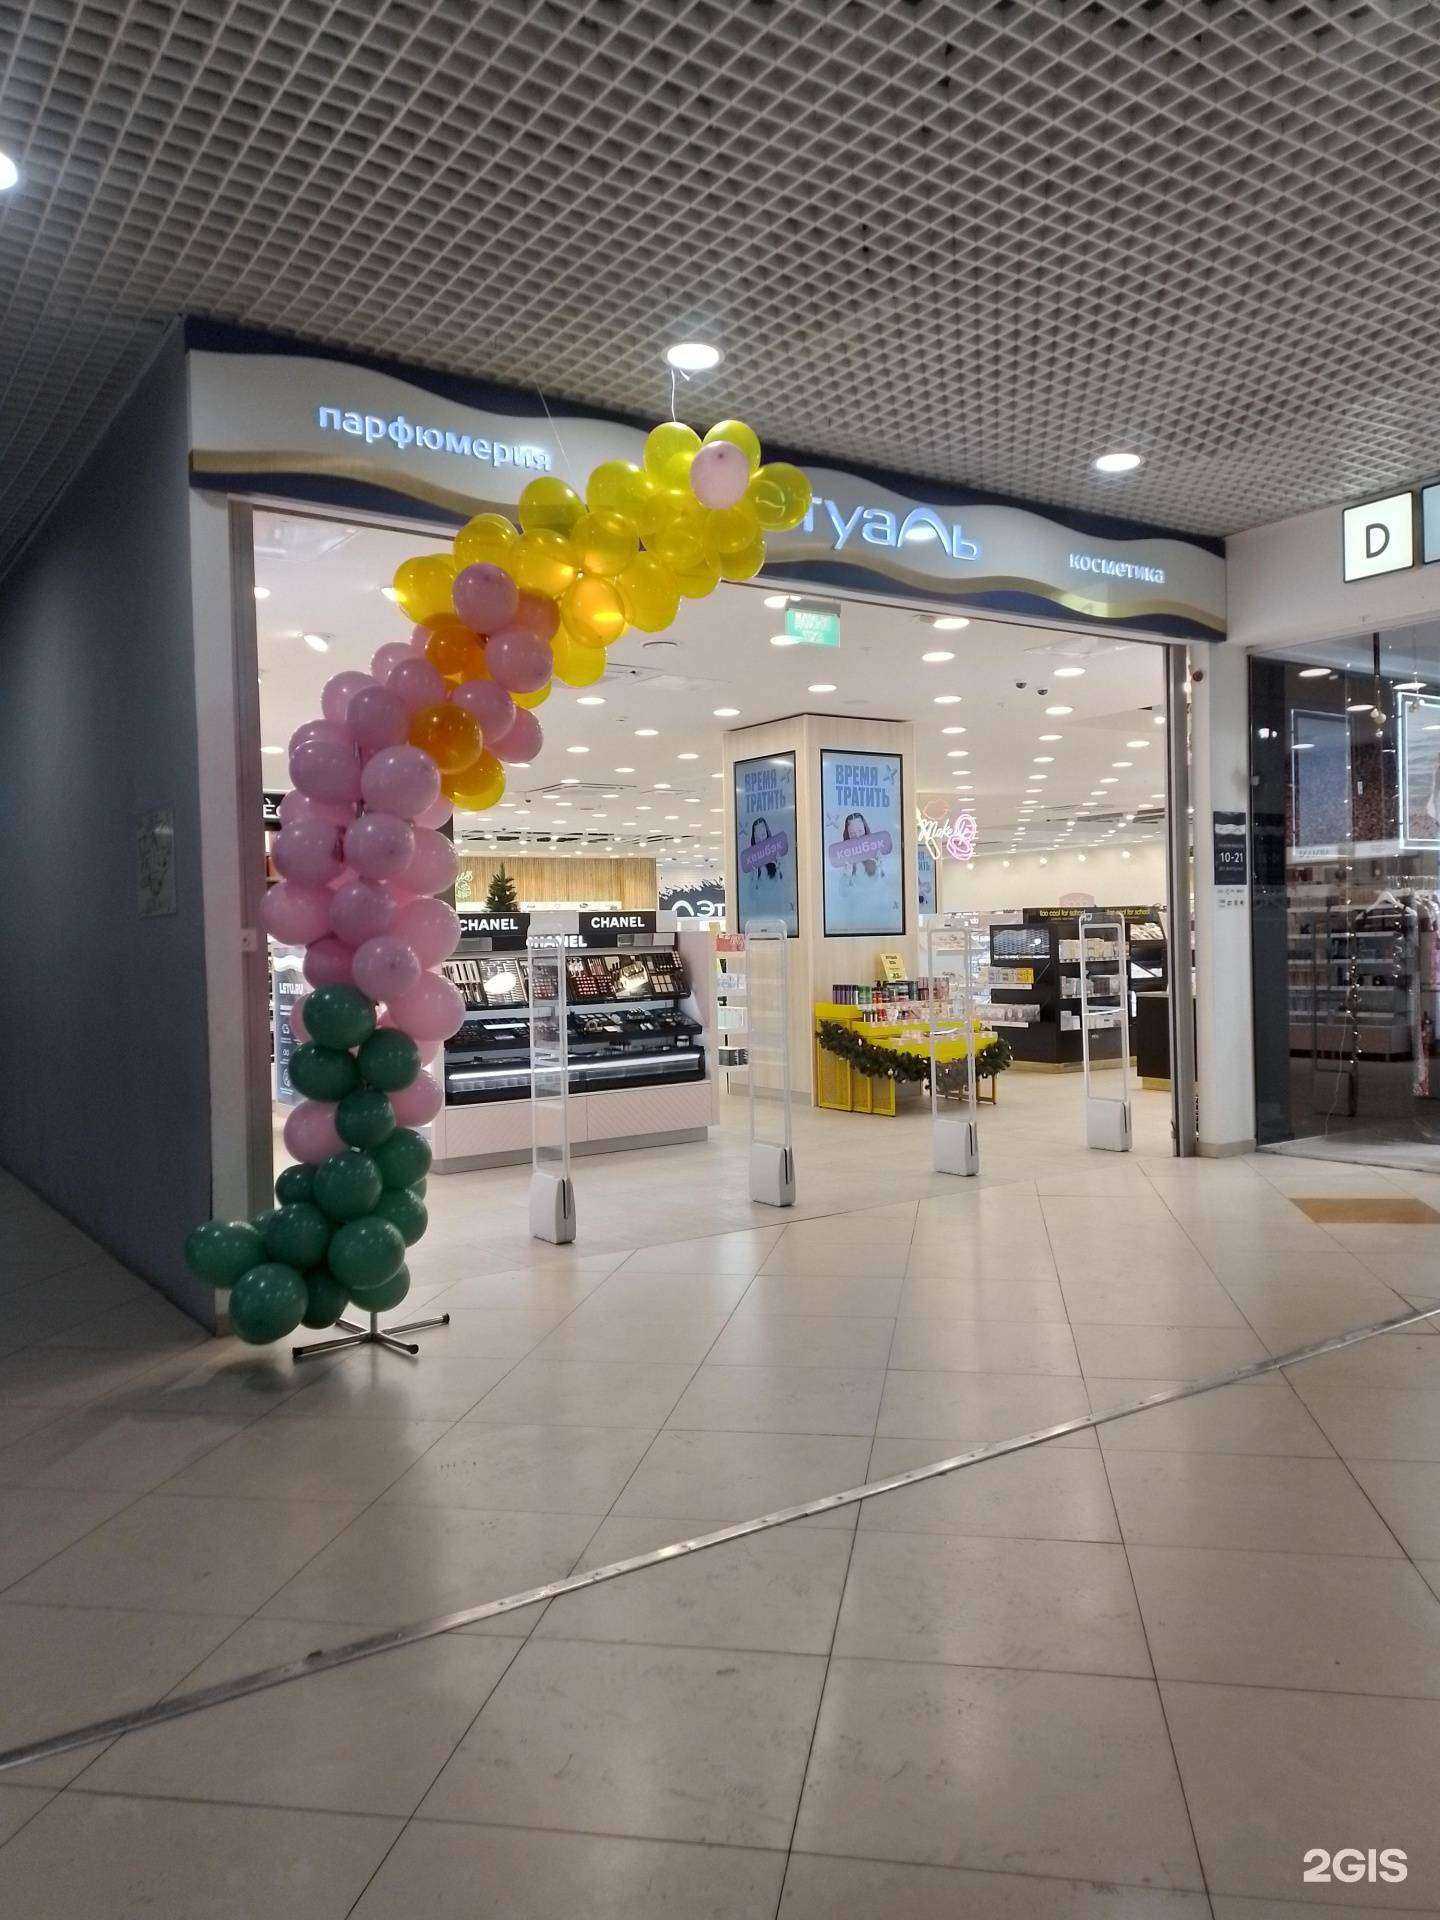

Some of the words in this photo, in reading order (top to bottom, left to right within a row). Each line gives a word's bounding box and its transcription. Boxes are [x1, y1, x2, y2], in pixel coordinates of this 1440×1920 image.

[319, 405, 552, 472] парфюмерия
[802, 496, 977, 561] туаль
[1365, 522, 1390, 559] D
[1068, 553, 1167, 584] косметика
[744, 769, 777, 792] ВРЕМЯ
[835, 764, 879, 786] ВРЕМЯ
[744, 790, 787, 814] ТРАТИТЬ
[836, 785, 891, 808] ТРАТИТЬ
[1220, 851, 1244, 863] 10-21
[458, 918, 519, 931] CHANEL
[590, 916, 645, 929] CHANEL
